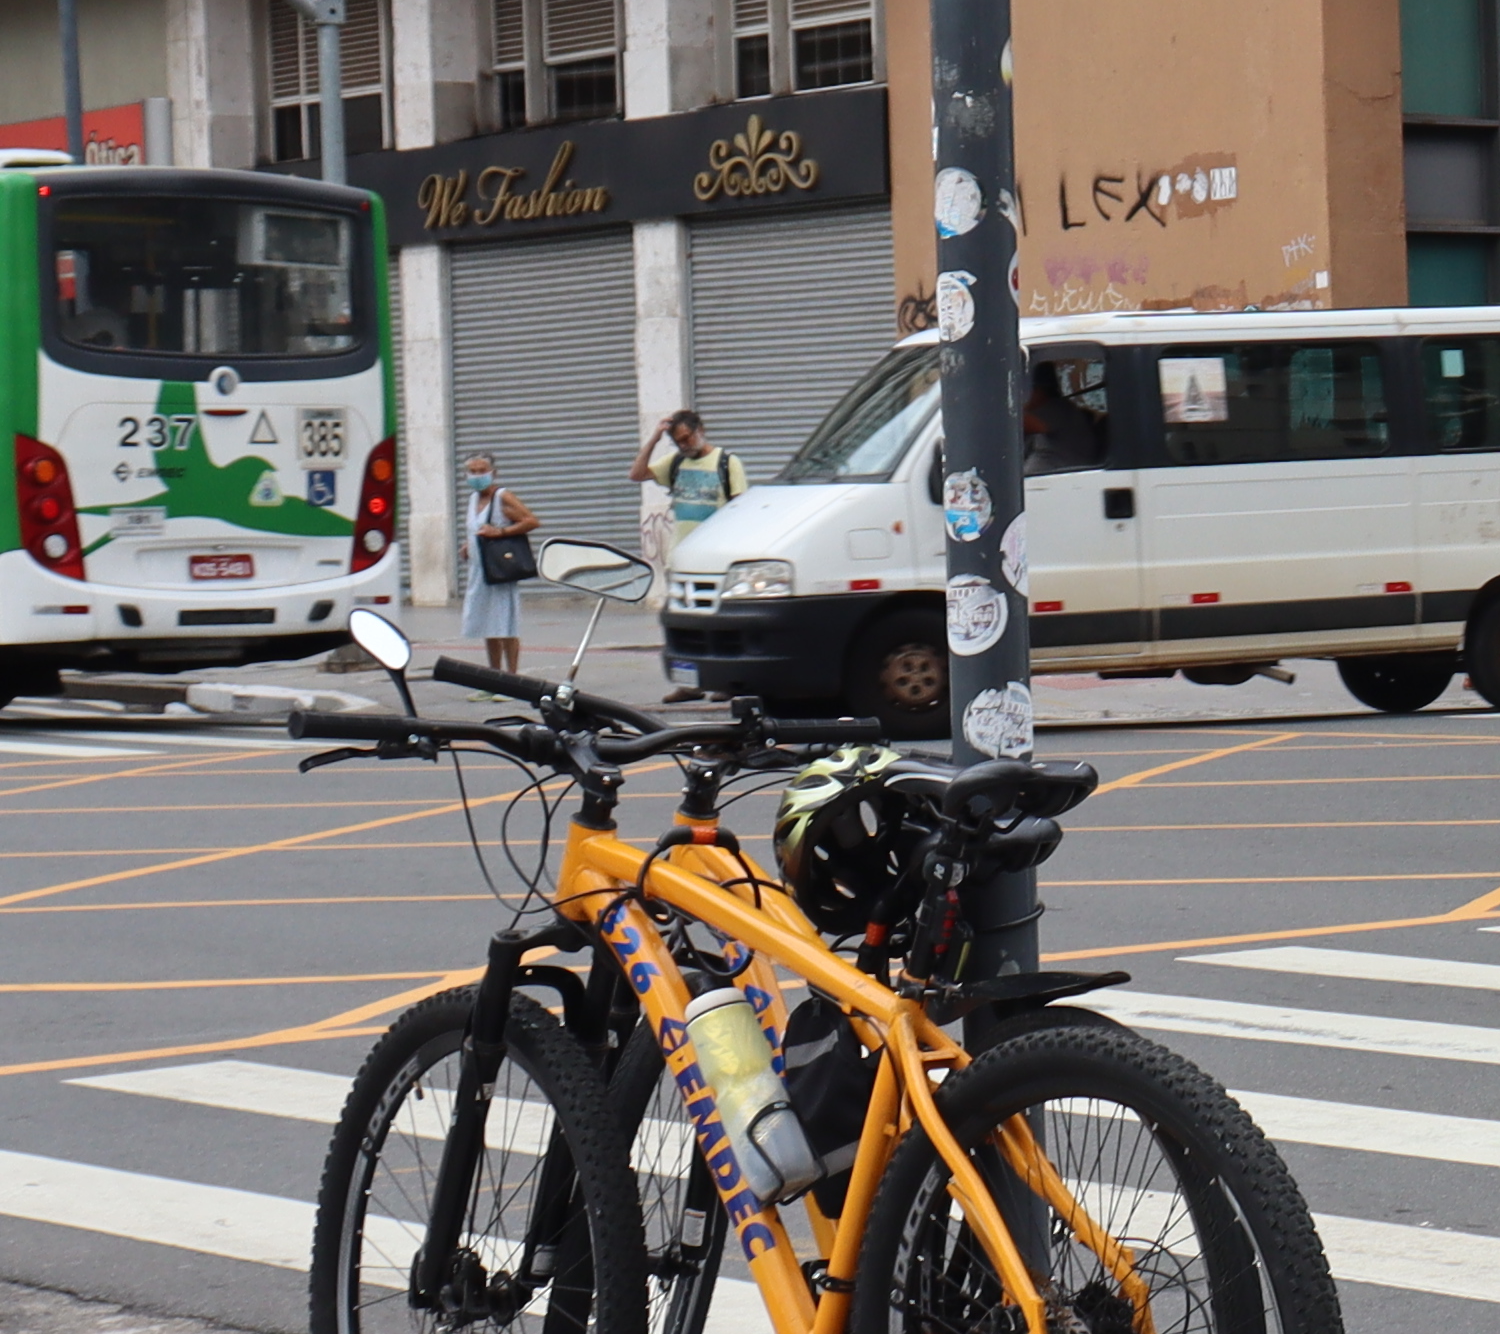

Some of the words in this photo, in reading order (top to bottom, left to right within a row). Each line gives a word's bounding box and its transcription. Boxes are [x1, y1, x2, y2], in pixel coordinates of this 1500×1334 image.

[418, 170, 468, 229] We
[474, 140, 608, 225] Fashion
[118, 417, 195, 449] 237
[302, 420, 343, 457] 385
[675, 1061, 775, 1262] EMDEC
